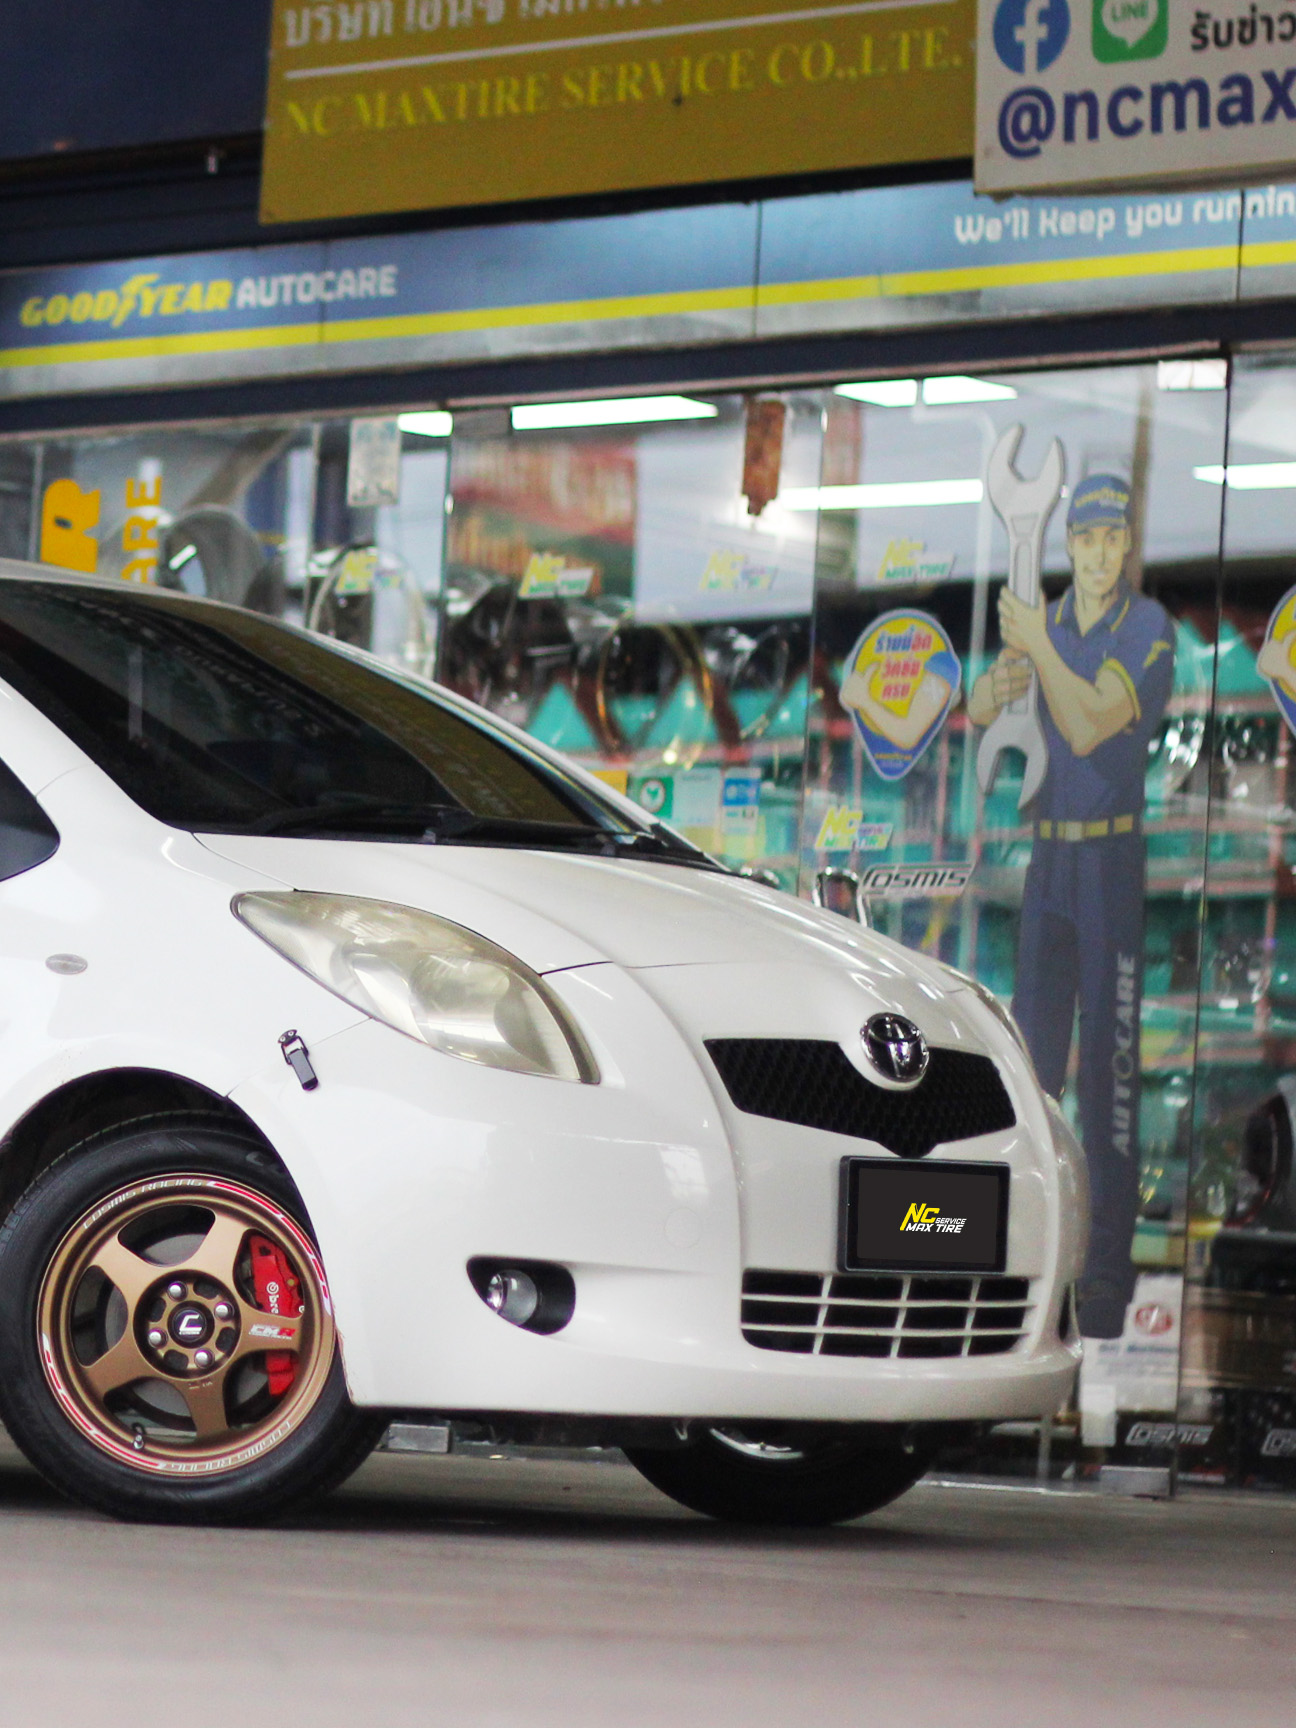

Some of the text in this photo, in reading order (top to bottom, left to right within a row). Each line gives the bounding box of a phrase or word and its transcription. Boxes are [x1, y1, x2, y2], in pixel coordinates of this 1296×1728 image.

[287, 99, 344, 137] NC
[561, 49, 754, 109] SERVICE
[954, 206, 1030, 244] We'll
[1125, 202, 1183, 237] you
[19, 264, 398, 328] GOODYEAR AUTOCARE
[1111, 951, 1136, 1158] AUTOCARE
